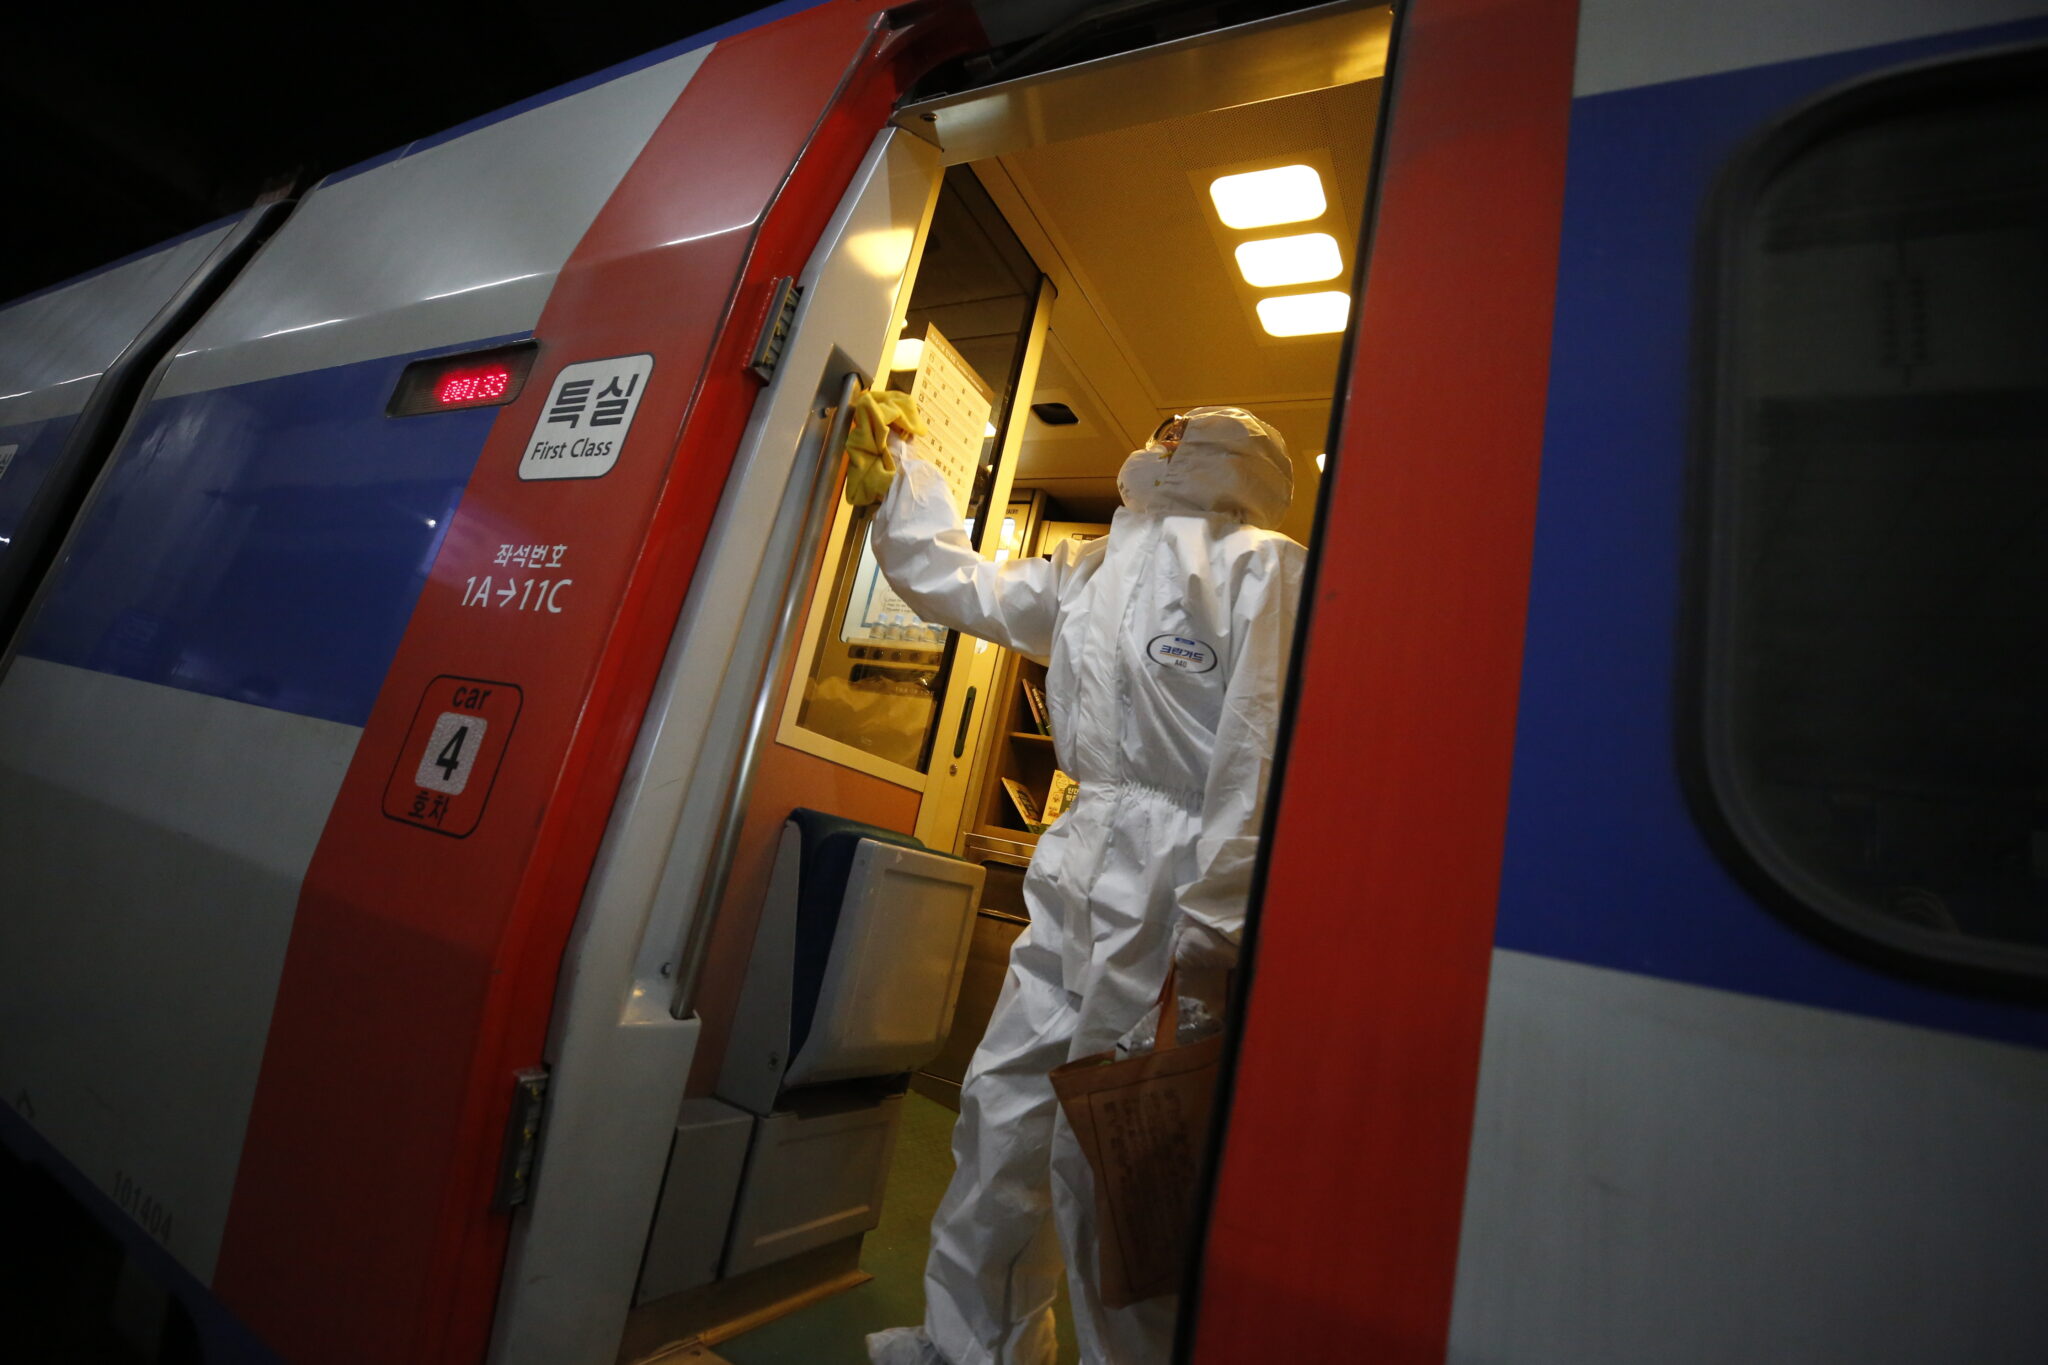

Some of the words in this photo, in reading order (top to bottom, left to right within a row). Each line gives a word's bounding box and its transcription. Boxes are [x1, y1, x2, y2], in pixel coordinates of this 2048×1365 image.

[547, 373, 640, 429] 특실
[530, 441, 567, 461] First
[570, 438, 613, 458] Class
[494, 544, 568, 568] 좌석번호
[452, 686, 492, 710] car
[435, 726, 469, 781] 4
[408, 790, 450, 826] 호차
[113, 1170, 173, 1242] 101404
